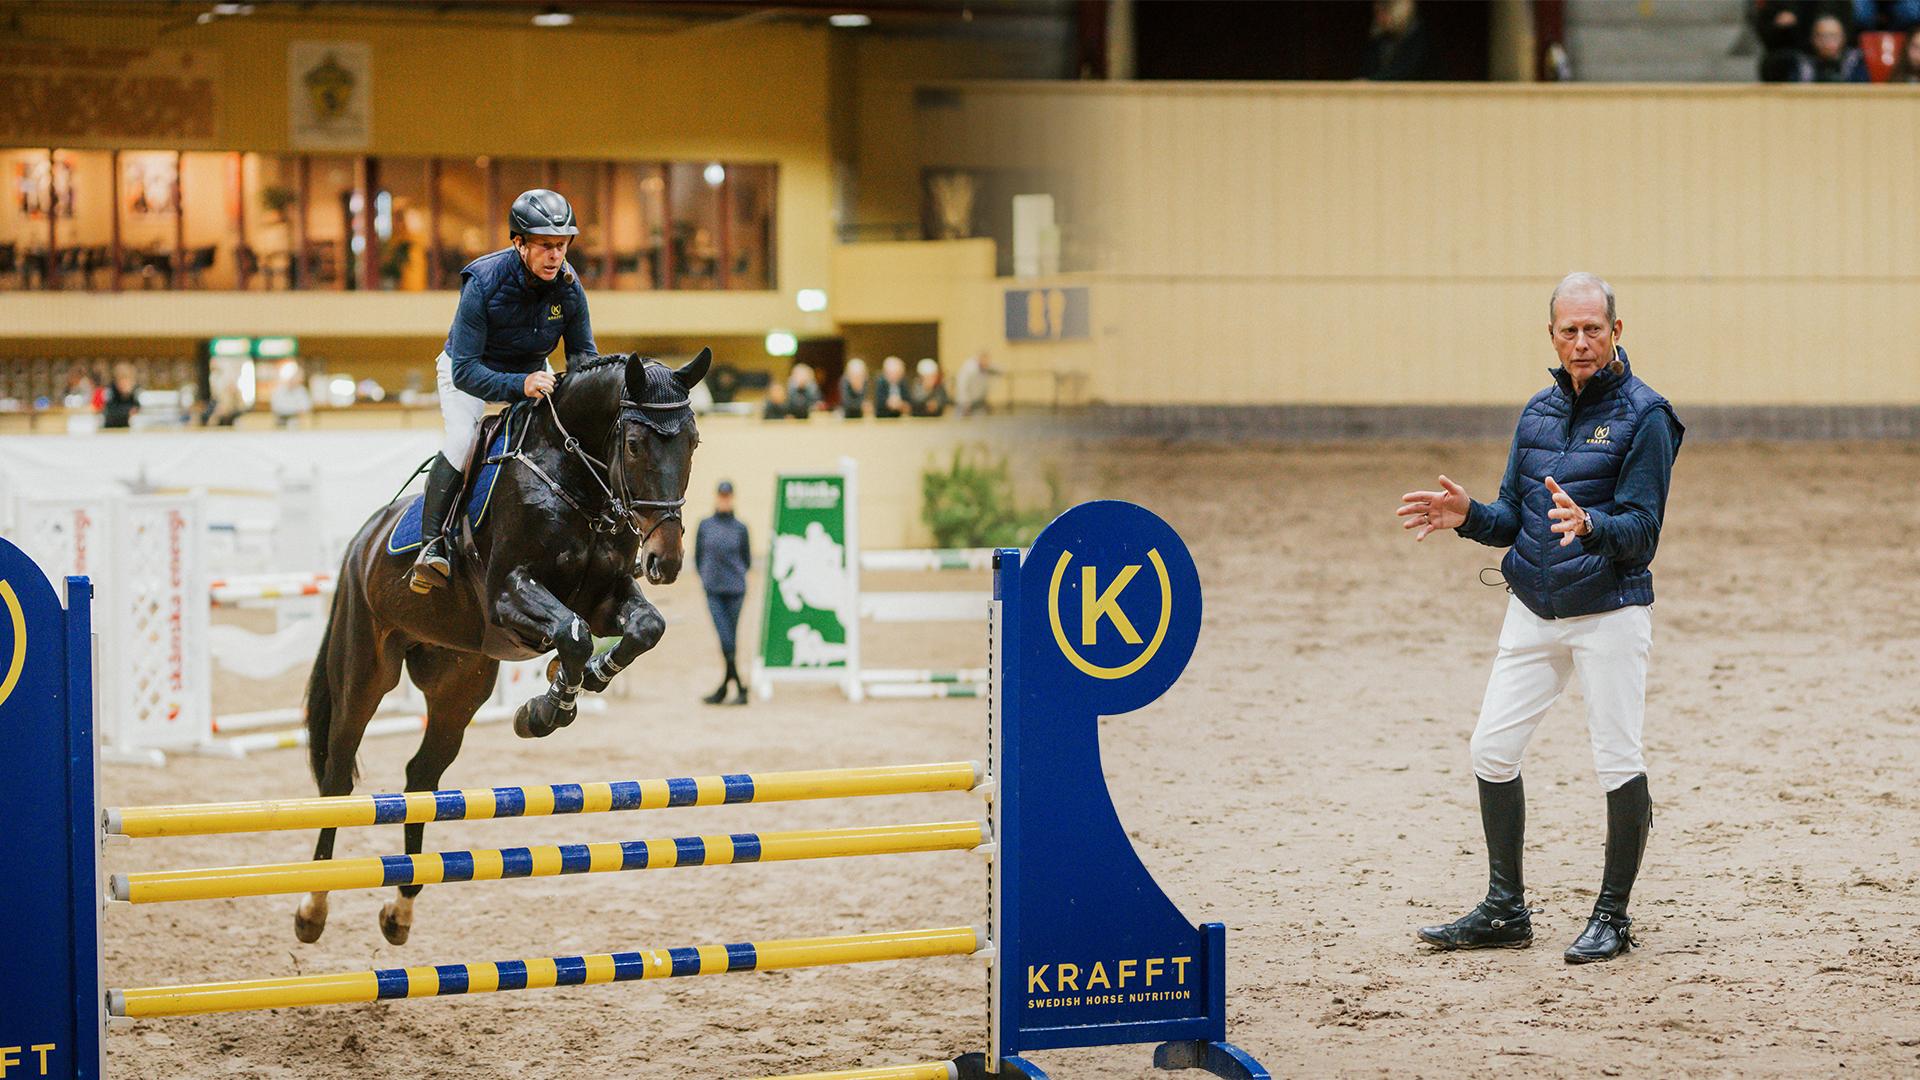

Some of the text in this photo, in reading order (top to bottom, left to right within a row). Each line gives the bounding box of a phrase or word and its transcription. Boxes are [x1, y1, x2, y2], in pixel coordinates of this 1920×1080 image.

[1081, 564, 1144, 646] K
[1027, 956, 1192, 994] KRAFFT
[1028, 990, 1190, 1009] SWEDISH HORSE NUTRITION
